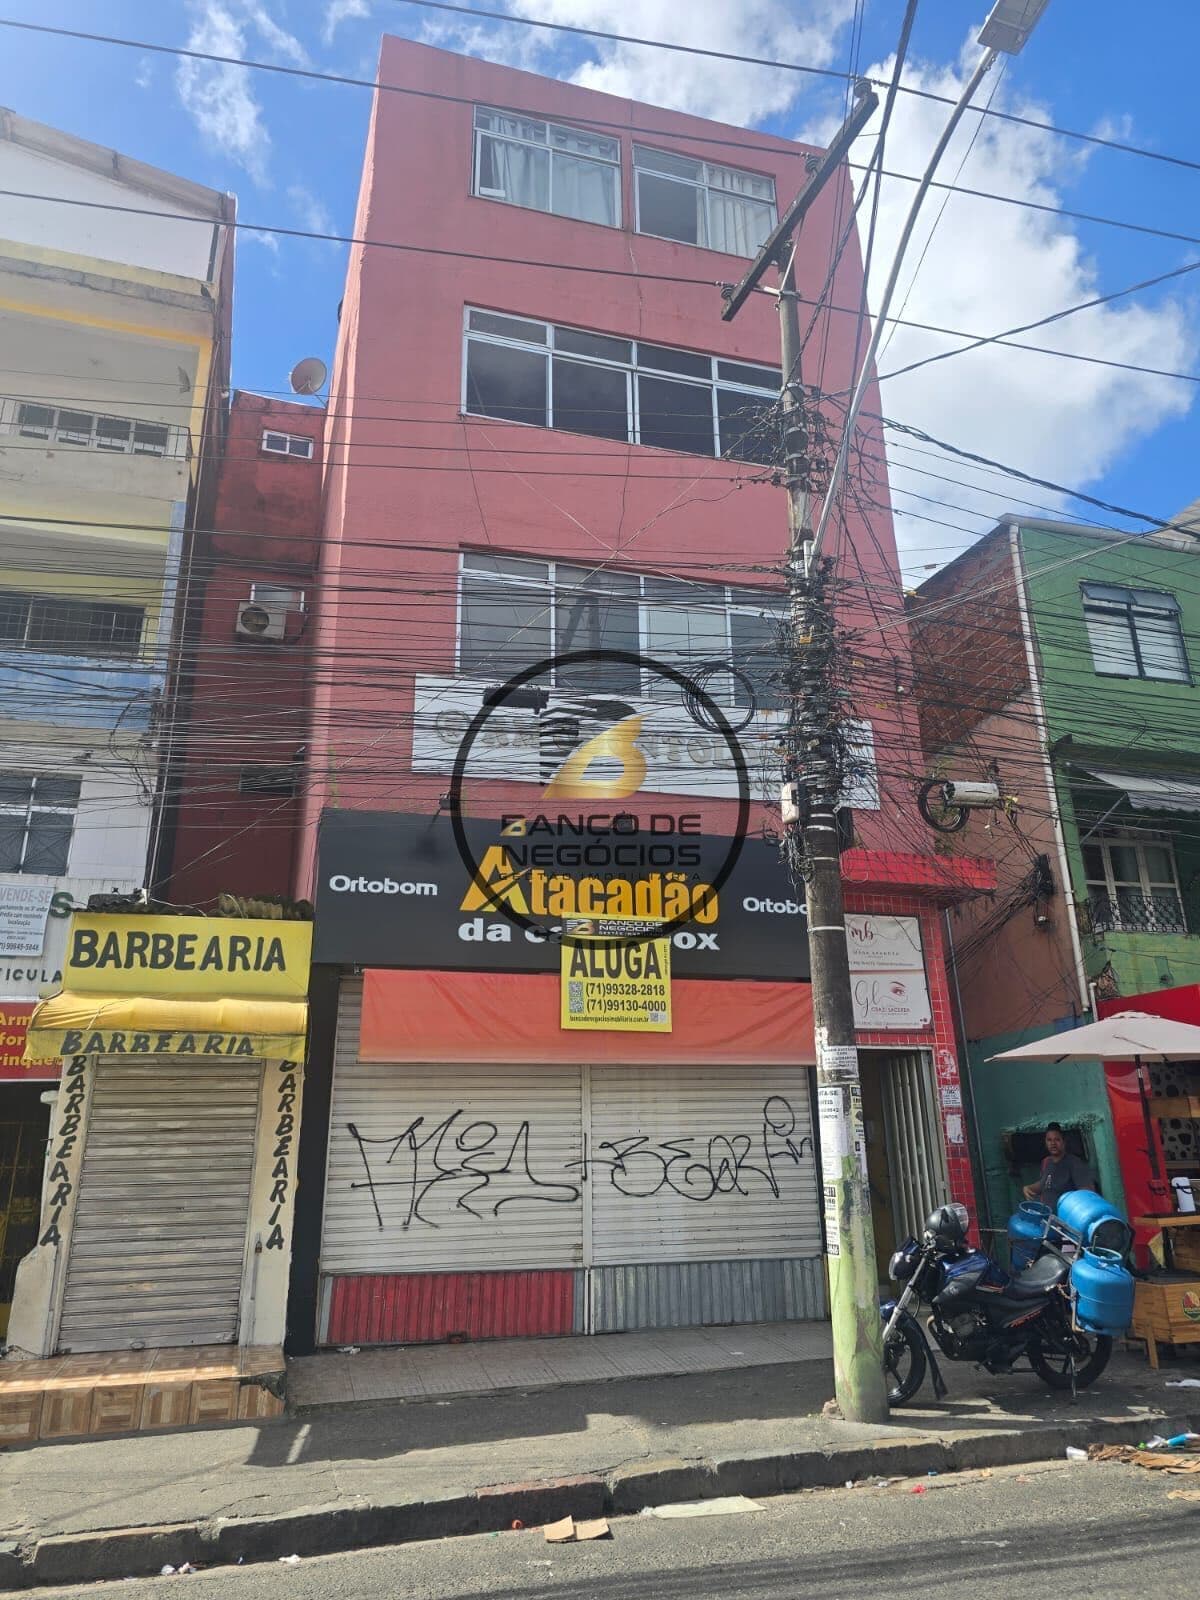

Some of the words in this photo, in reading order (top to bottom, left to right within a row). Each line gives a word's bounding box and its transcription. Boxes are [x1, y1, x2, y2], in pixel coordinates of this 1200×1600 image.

[329, 875, 438, 896] Ortobom
[459, 845, 719, 924] Atacadão
[743, 897, 808, 914] Ortobo
[458, 918, 511, 942] da
[669, 932, 720, 950] ox
[70, 929, 286, 972] BARBEARIA
[570, 938, 662, 979] ALUGA
[586, 983, 665, 997] (71)99328-2818
[586, 999, 666, 1013] (71)99130-4000
[60, 1031, 254, 1055] BARBEARIA
[40, 1055, 87, 1246] BARBEARIA
